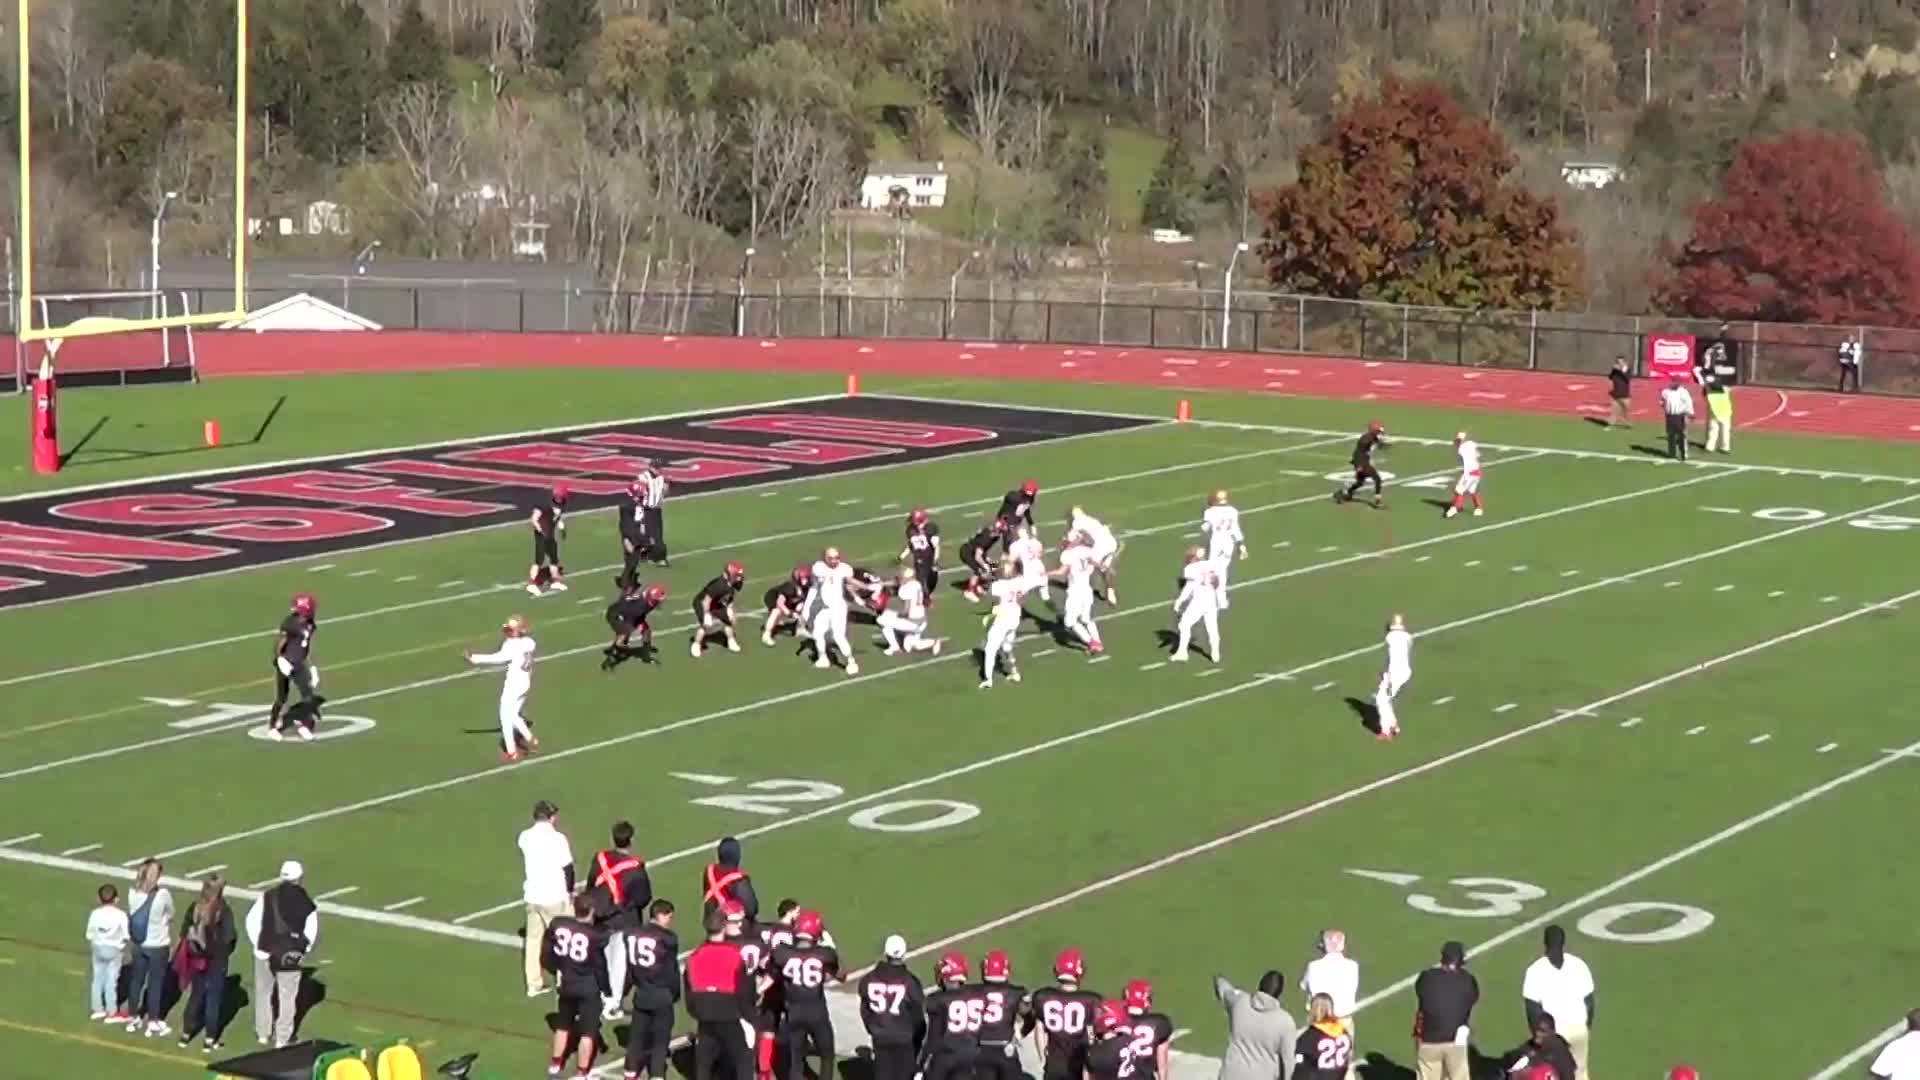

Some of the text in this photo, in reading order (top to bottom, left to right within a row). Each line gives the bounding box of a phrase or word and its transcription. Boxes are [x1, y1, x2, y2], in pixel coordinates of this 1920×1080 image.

[1405, 876, 1715, 943] 30
[553, 927, 589, 962] 38
[627, 935, 657, 967] 15
[782, 957, 823, 988] 46
[867, 982, 906, 1015] 57
[947, 1000, 983, 1033] 95
[1043, 1000, 1086, 1034] 60
[1317, 1034, 1350, 1069] 22
